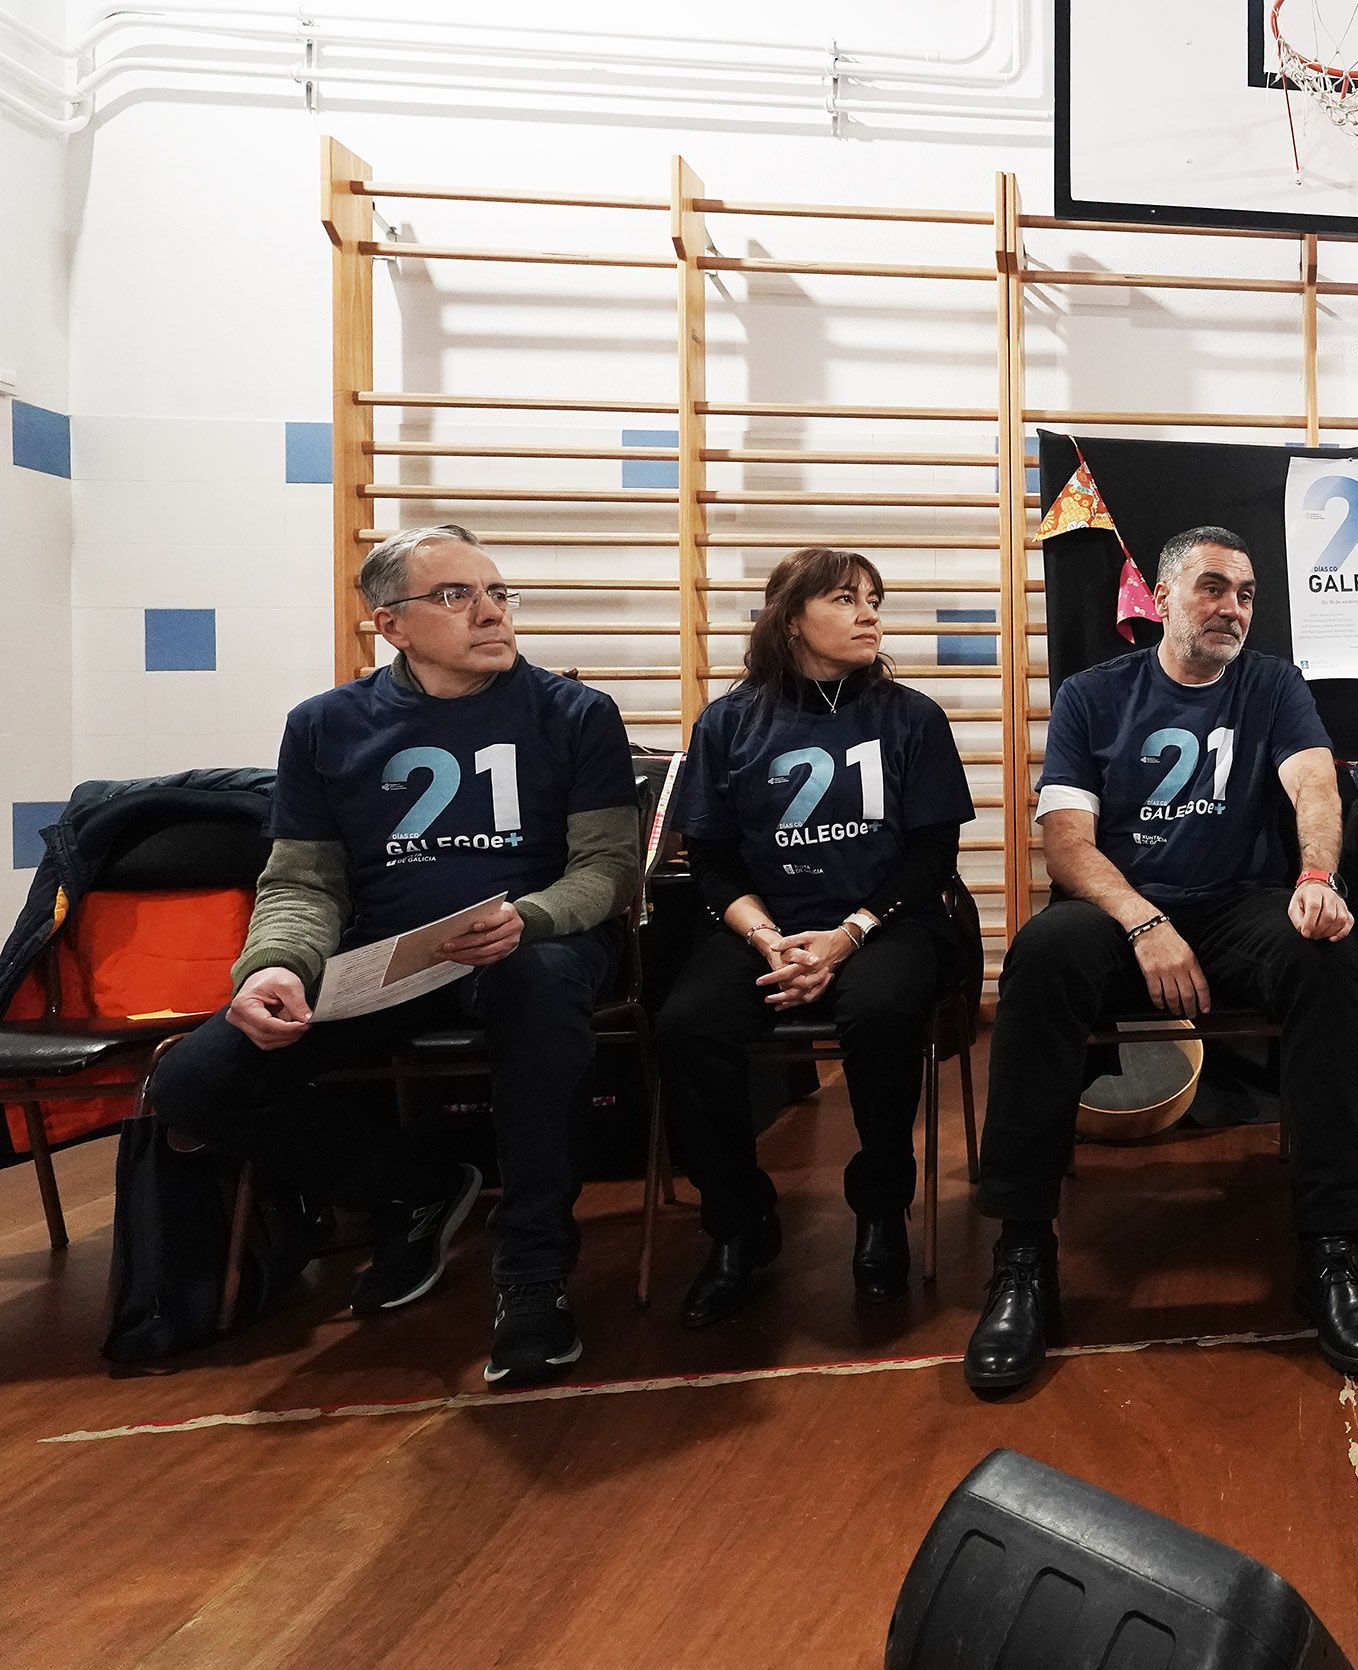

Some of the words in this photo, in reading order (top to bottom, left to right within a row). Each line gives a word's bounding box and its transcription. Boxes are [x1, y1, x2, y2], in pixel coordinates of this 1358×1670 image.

[381, 743, 522, 840] 21
[768, 738, 885, 829] 21
[1141, 726, 1235, 806] 21
